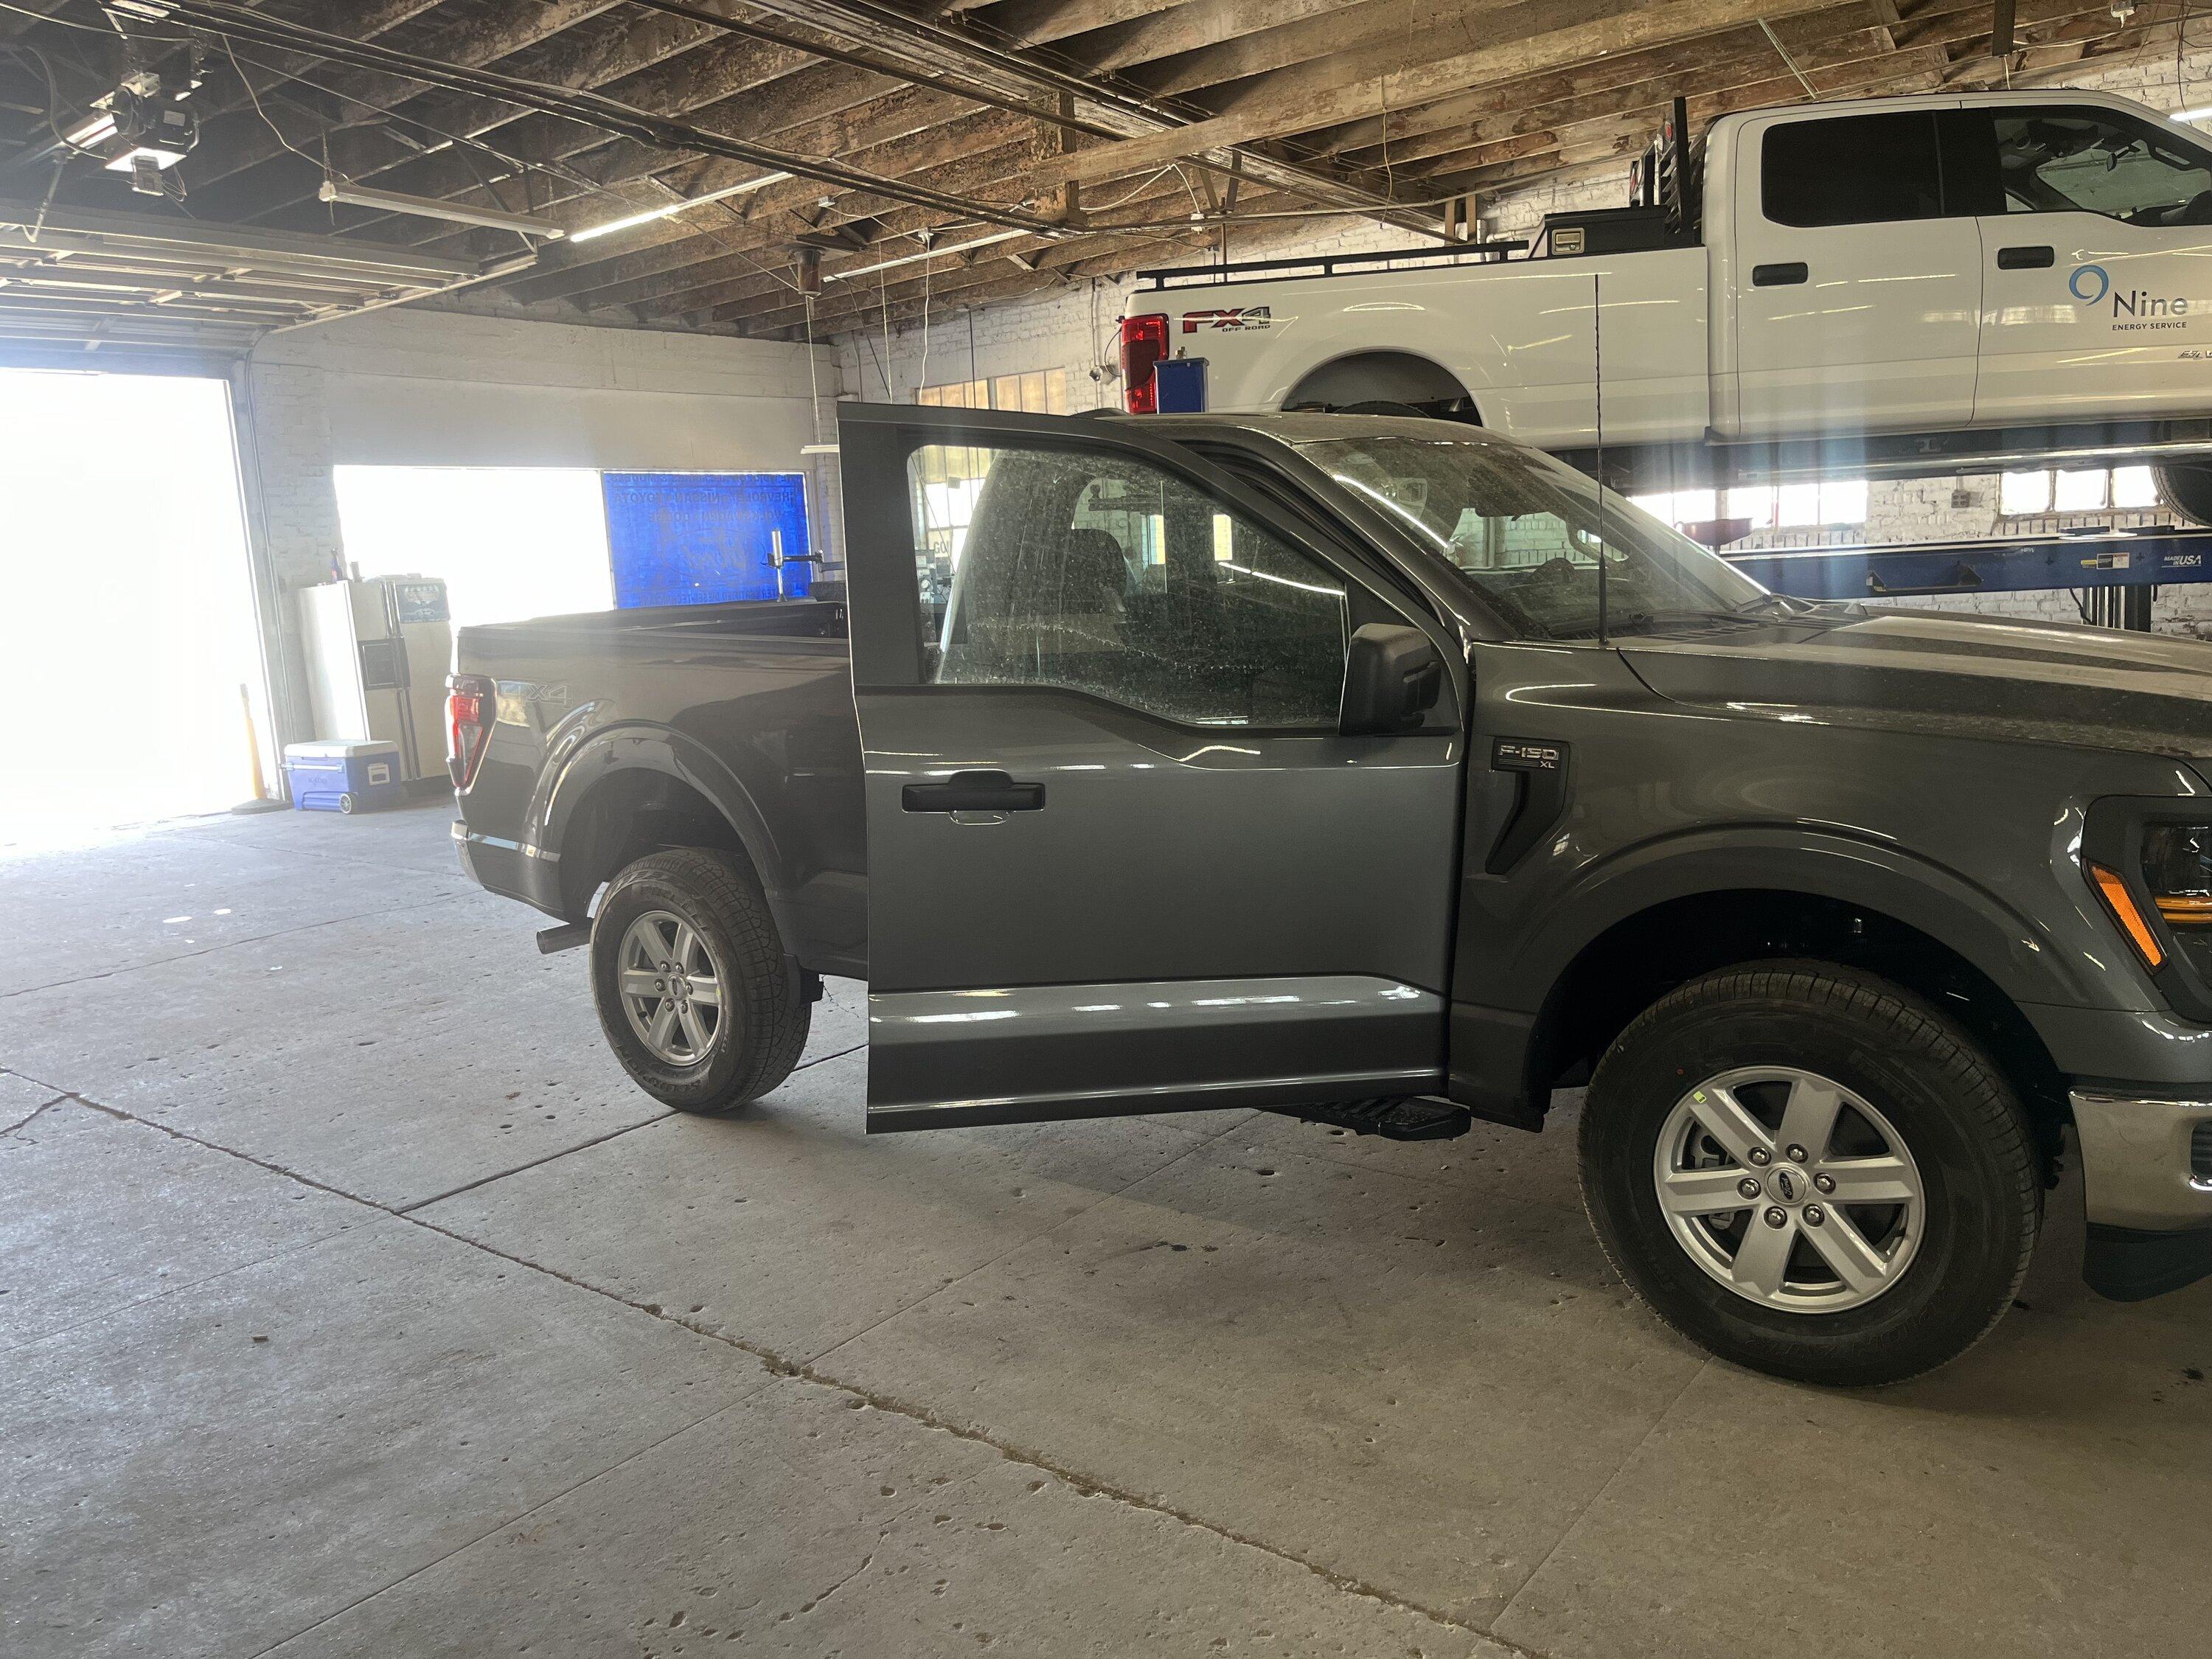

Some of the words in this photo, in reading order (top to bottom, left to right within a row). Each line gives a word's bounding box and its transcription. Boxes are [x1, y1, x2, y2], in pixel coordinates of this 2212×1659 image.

[2113, 290, 2188, 318] Nine
[1183, 306, 1271, 334] FX4
[2112, 323, 2148, 331] ENERGY
[2150, 321, 2188, 330] SERVICE
[2180, 554, 2202, 566] USA
[1498, 745, 1559, 760] F-150
[1540, 760, 1555, 768] XL
